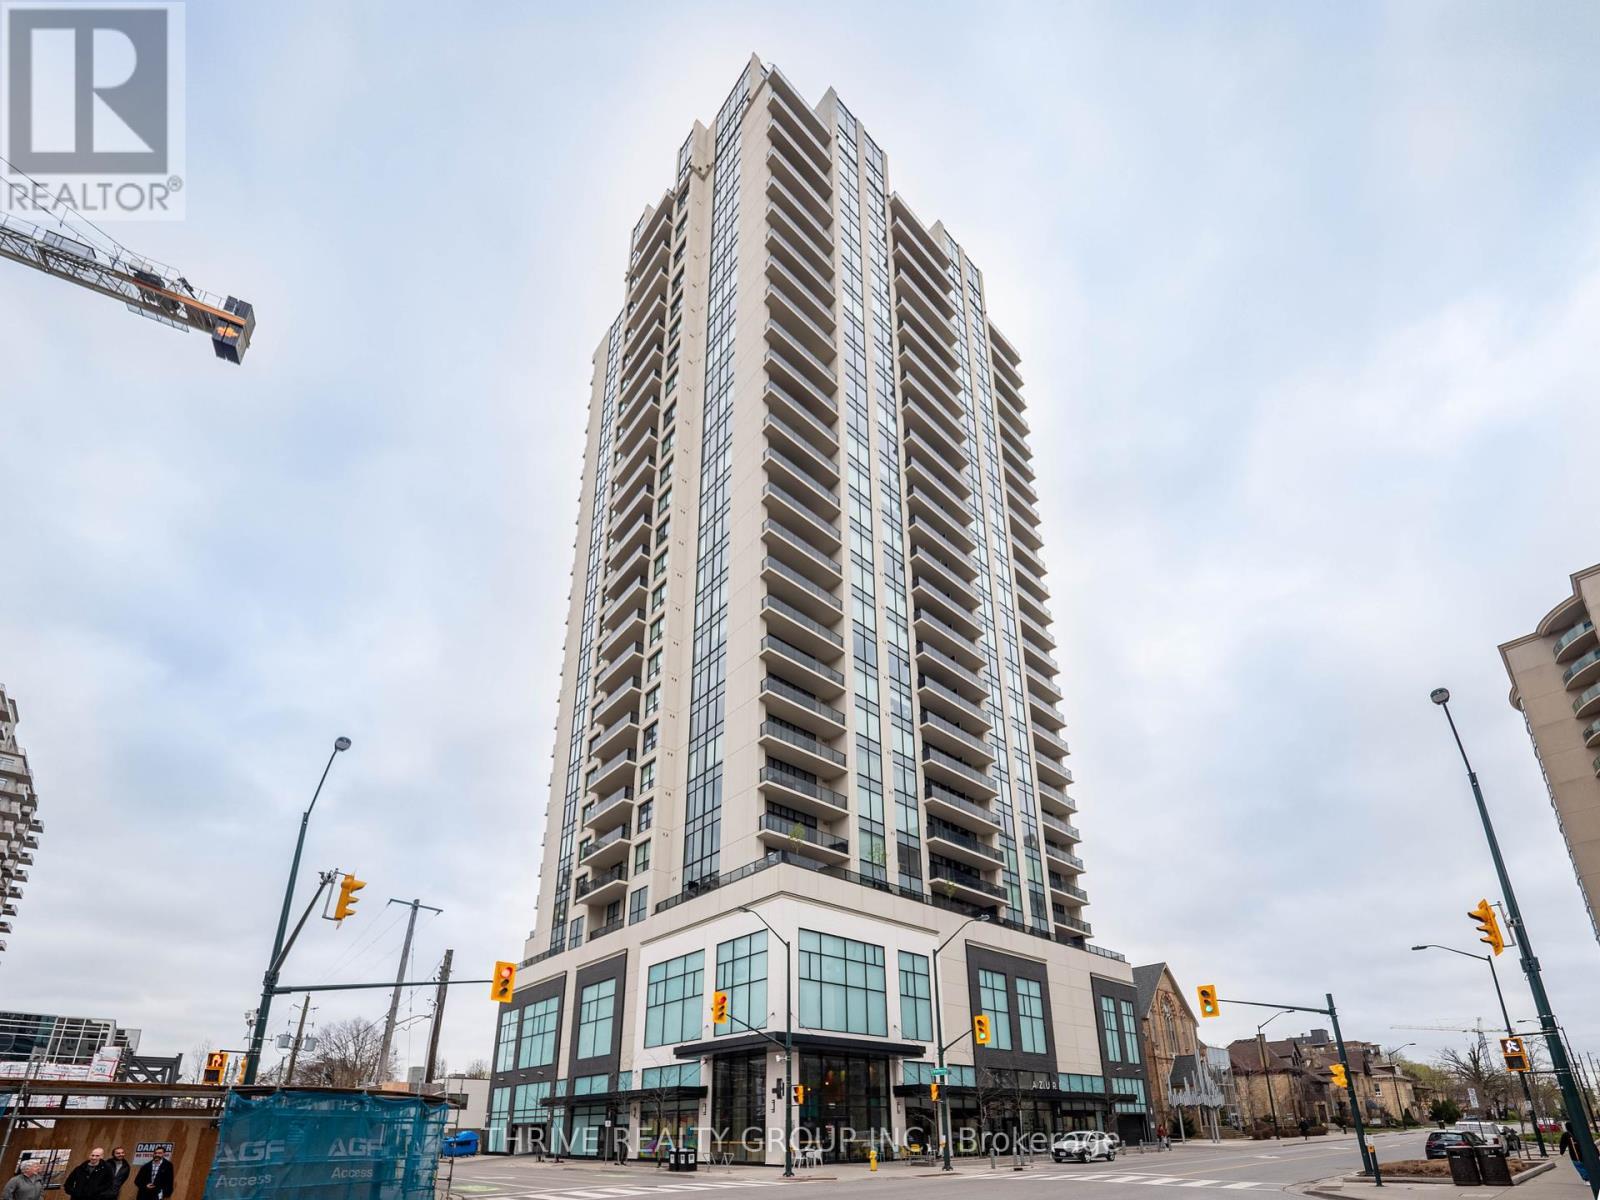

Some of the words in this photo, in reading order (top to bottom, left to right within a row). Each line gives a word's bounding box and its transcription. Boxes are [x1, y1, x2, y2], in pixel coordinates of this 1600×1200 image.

[217, 1140, 285, 1163] AGF
[328, 1138, 383, 1156] AGF
[215, 1174, 272, 1188] Access
[331, 1167, 373, 1179] Access
